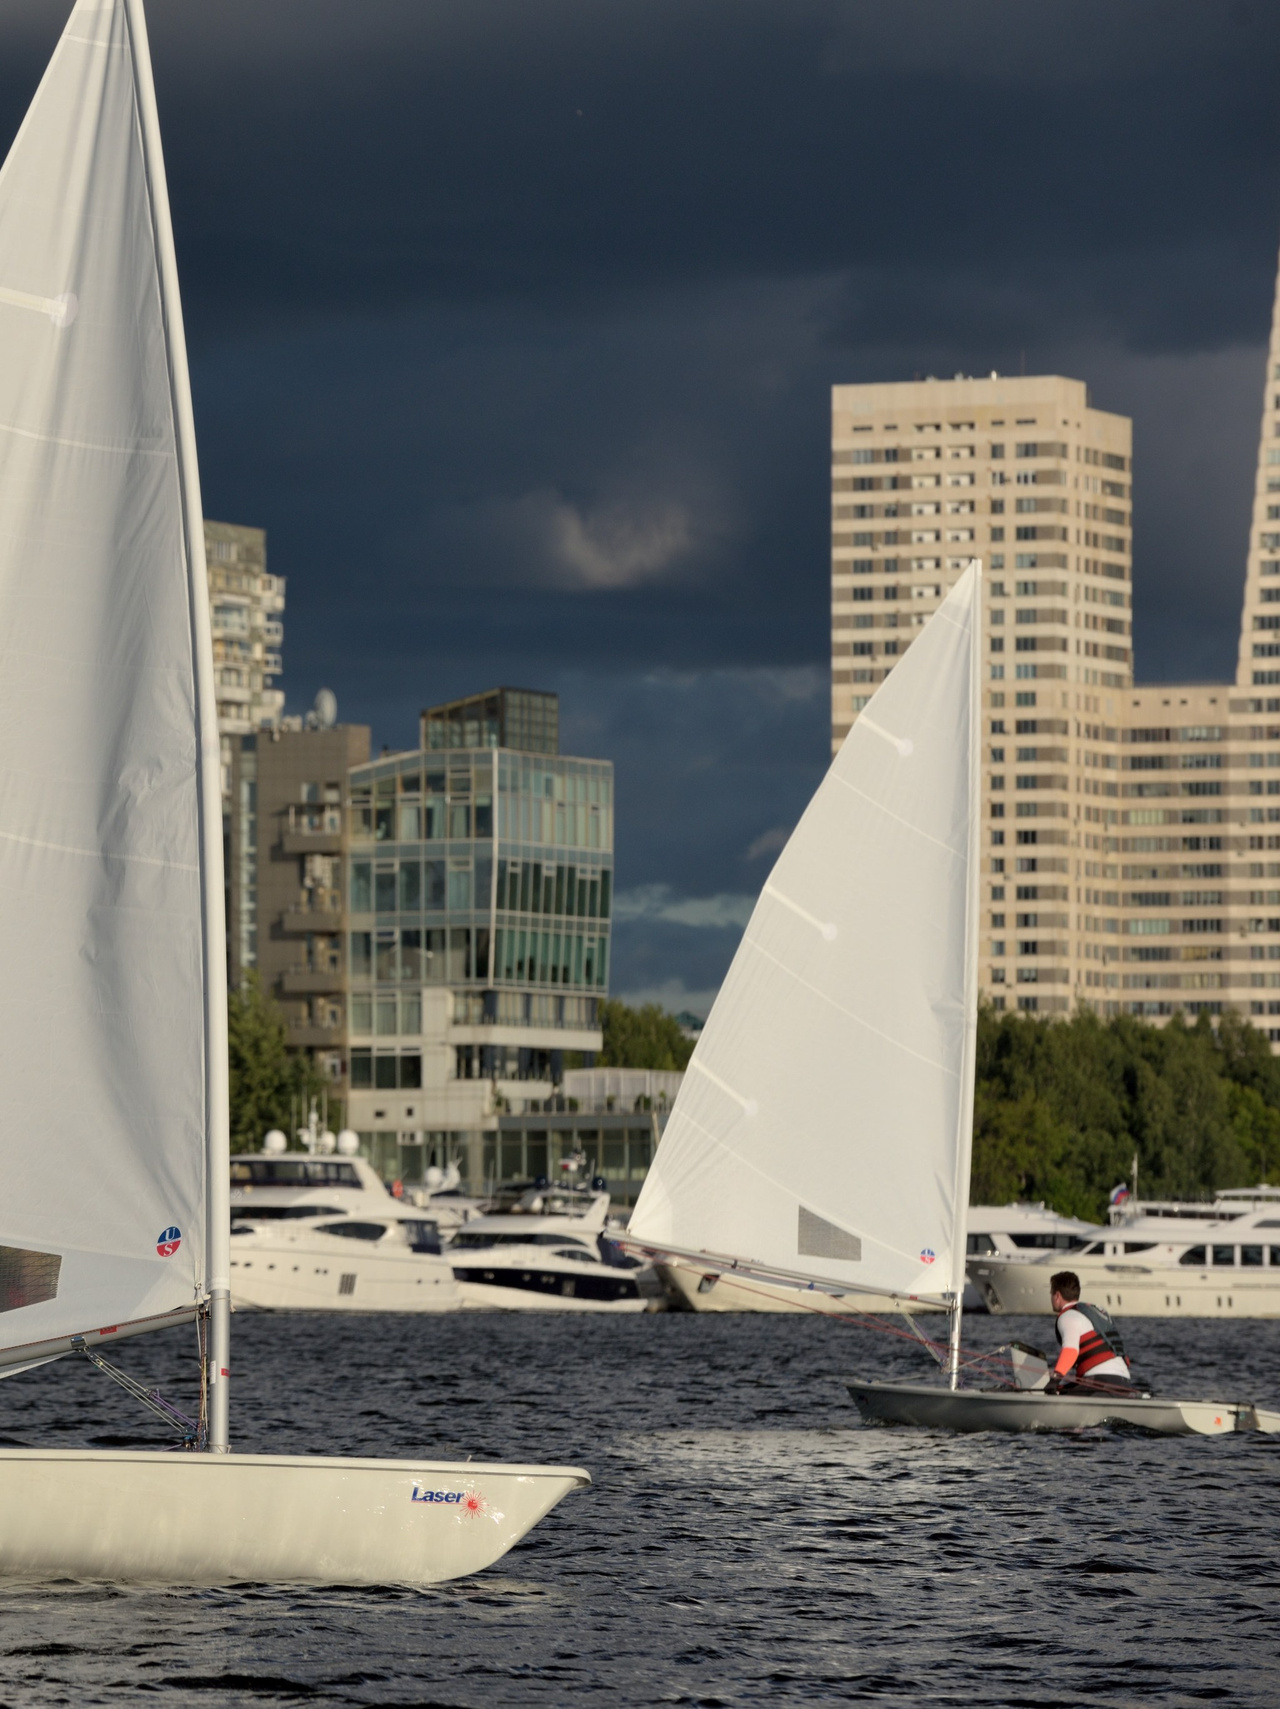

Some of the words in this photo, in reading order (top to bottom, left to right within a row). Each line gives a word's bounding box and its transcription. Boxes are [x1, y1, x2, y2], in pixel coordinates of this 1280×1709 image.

[165, 1227, 176, 1240] U
[163, 1243, 173, 1256] S
[411, 1487, 465, 1503] Laser
